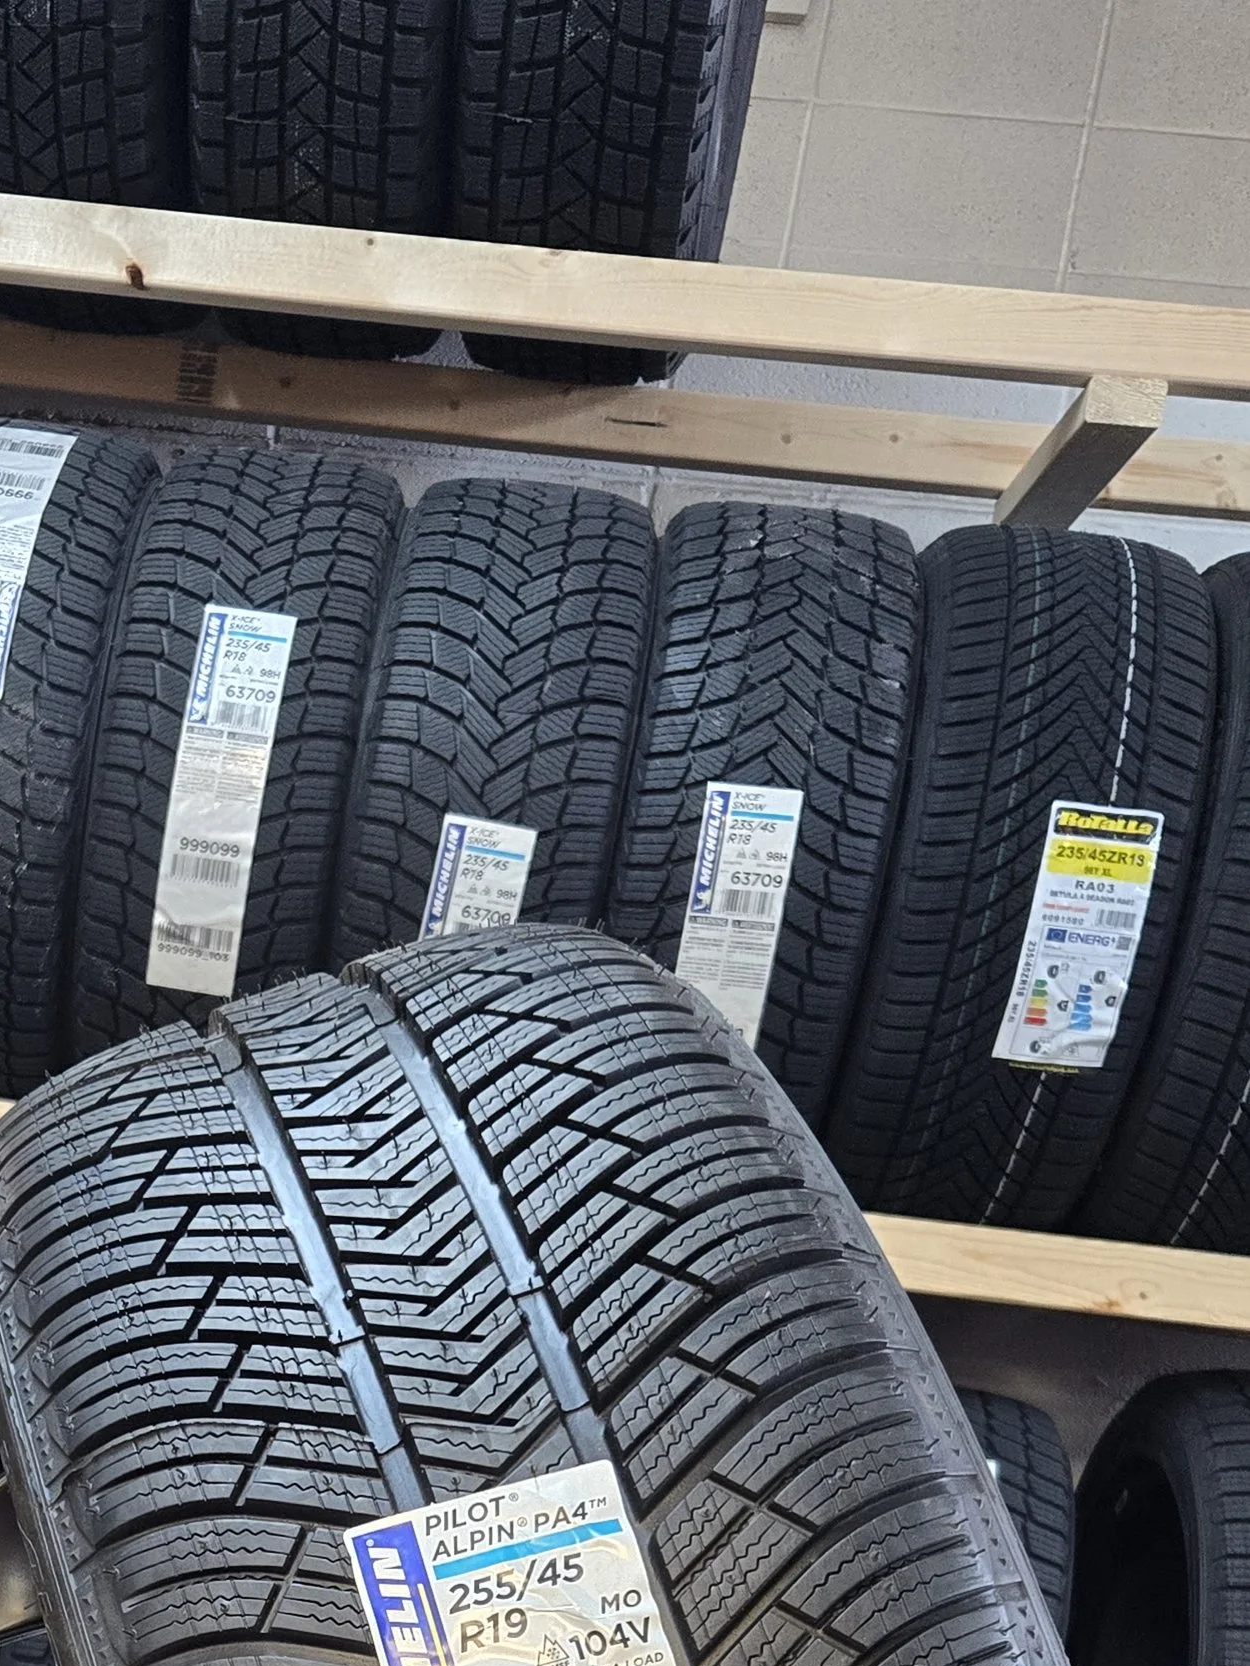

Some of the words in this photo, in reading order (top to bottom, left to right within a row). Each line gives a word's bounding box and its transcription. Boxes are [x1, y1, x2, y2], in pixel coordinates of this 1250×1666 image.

[225, 637, 271, 652] 235/45
[194, 613, 222, 698] MICHELIN
[222, 650, 246, 661] R18
[224, 684, 276, 703] 63709
[731, 801, 766, 811] SNOW
[729, 818, 777, 834] 235/45
[179, 836, 240, 857] 999099
[466, 836, 501, 849] SNOW
[699, 791, 726, 886] MICHELIN
[727, 832, 751, 845] R18
[462, 853, 509, 871] 235/45
[430, 825, 461, 918] MICHELIN
[459, 867, 484, 880] R18
[730, 869, 783, 889] 63709
[496, 888, 518, 900] 98H
[1074, 879, 1115, 893] RA03
[442, 1547, 588, 1618] 255/45
[597, 1586, 644, 1616] MO
[454, 1605, 532, 1654] R19
[567, 1614, 656, 1662] 104V
